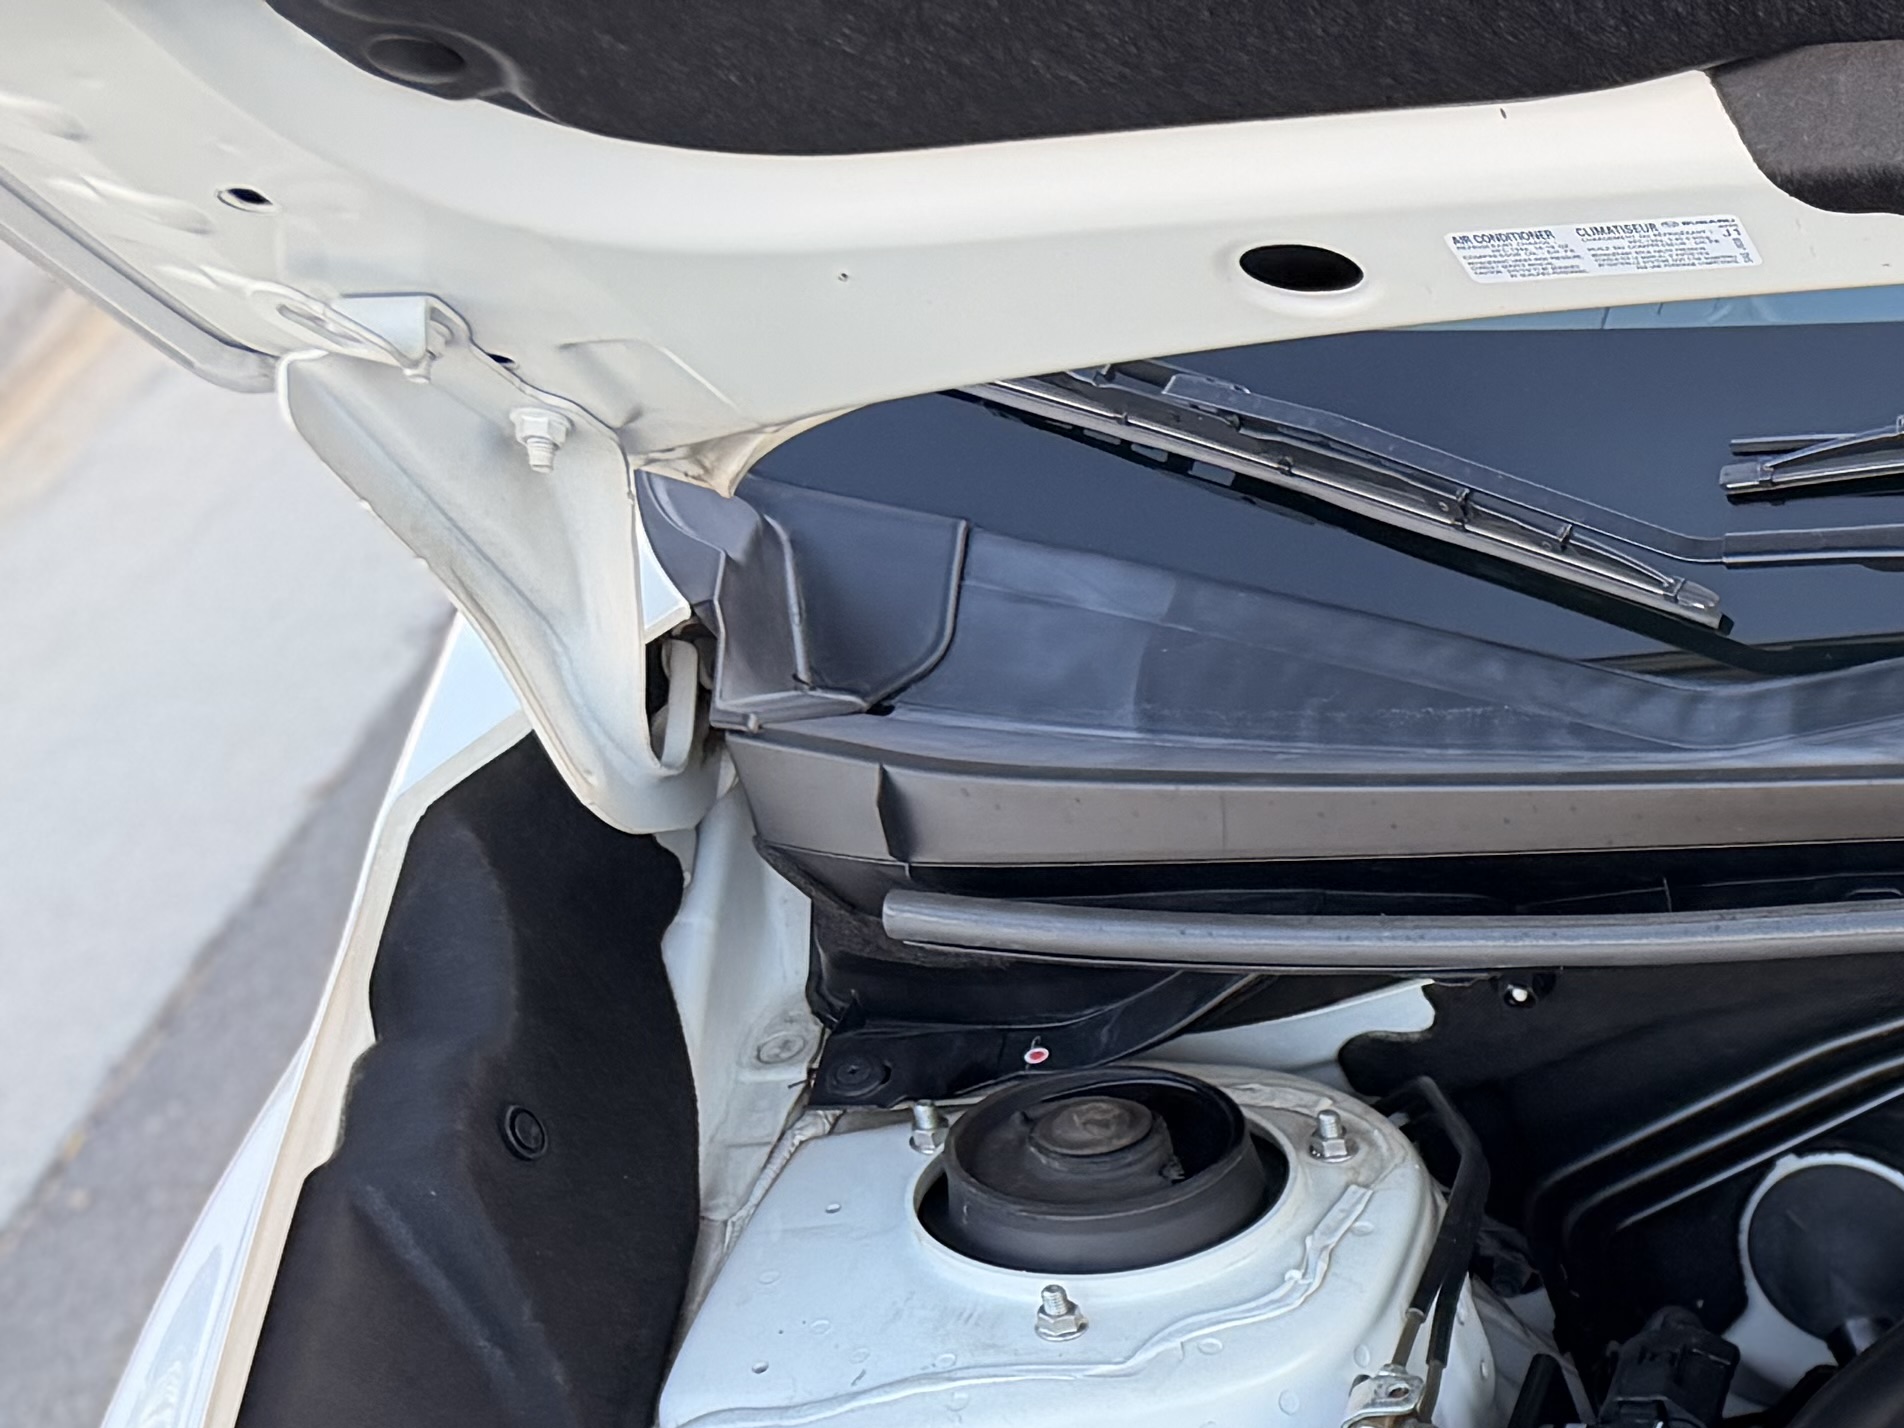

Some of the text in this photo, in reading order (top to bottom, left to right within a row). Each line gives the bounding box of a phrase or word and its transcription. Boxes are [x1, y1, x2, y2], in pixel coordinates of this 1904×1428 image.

[1452, 229, 1556, 246] AIR CONDITIONER
[1576, 222, 1659, 238] CLIMATISEUR
